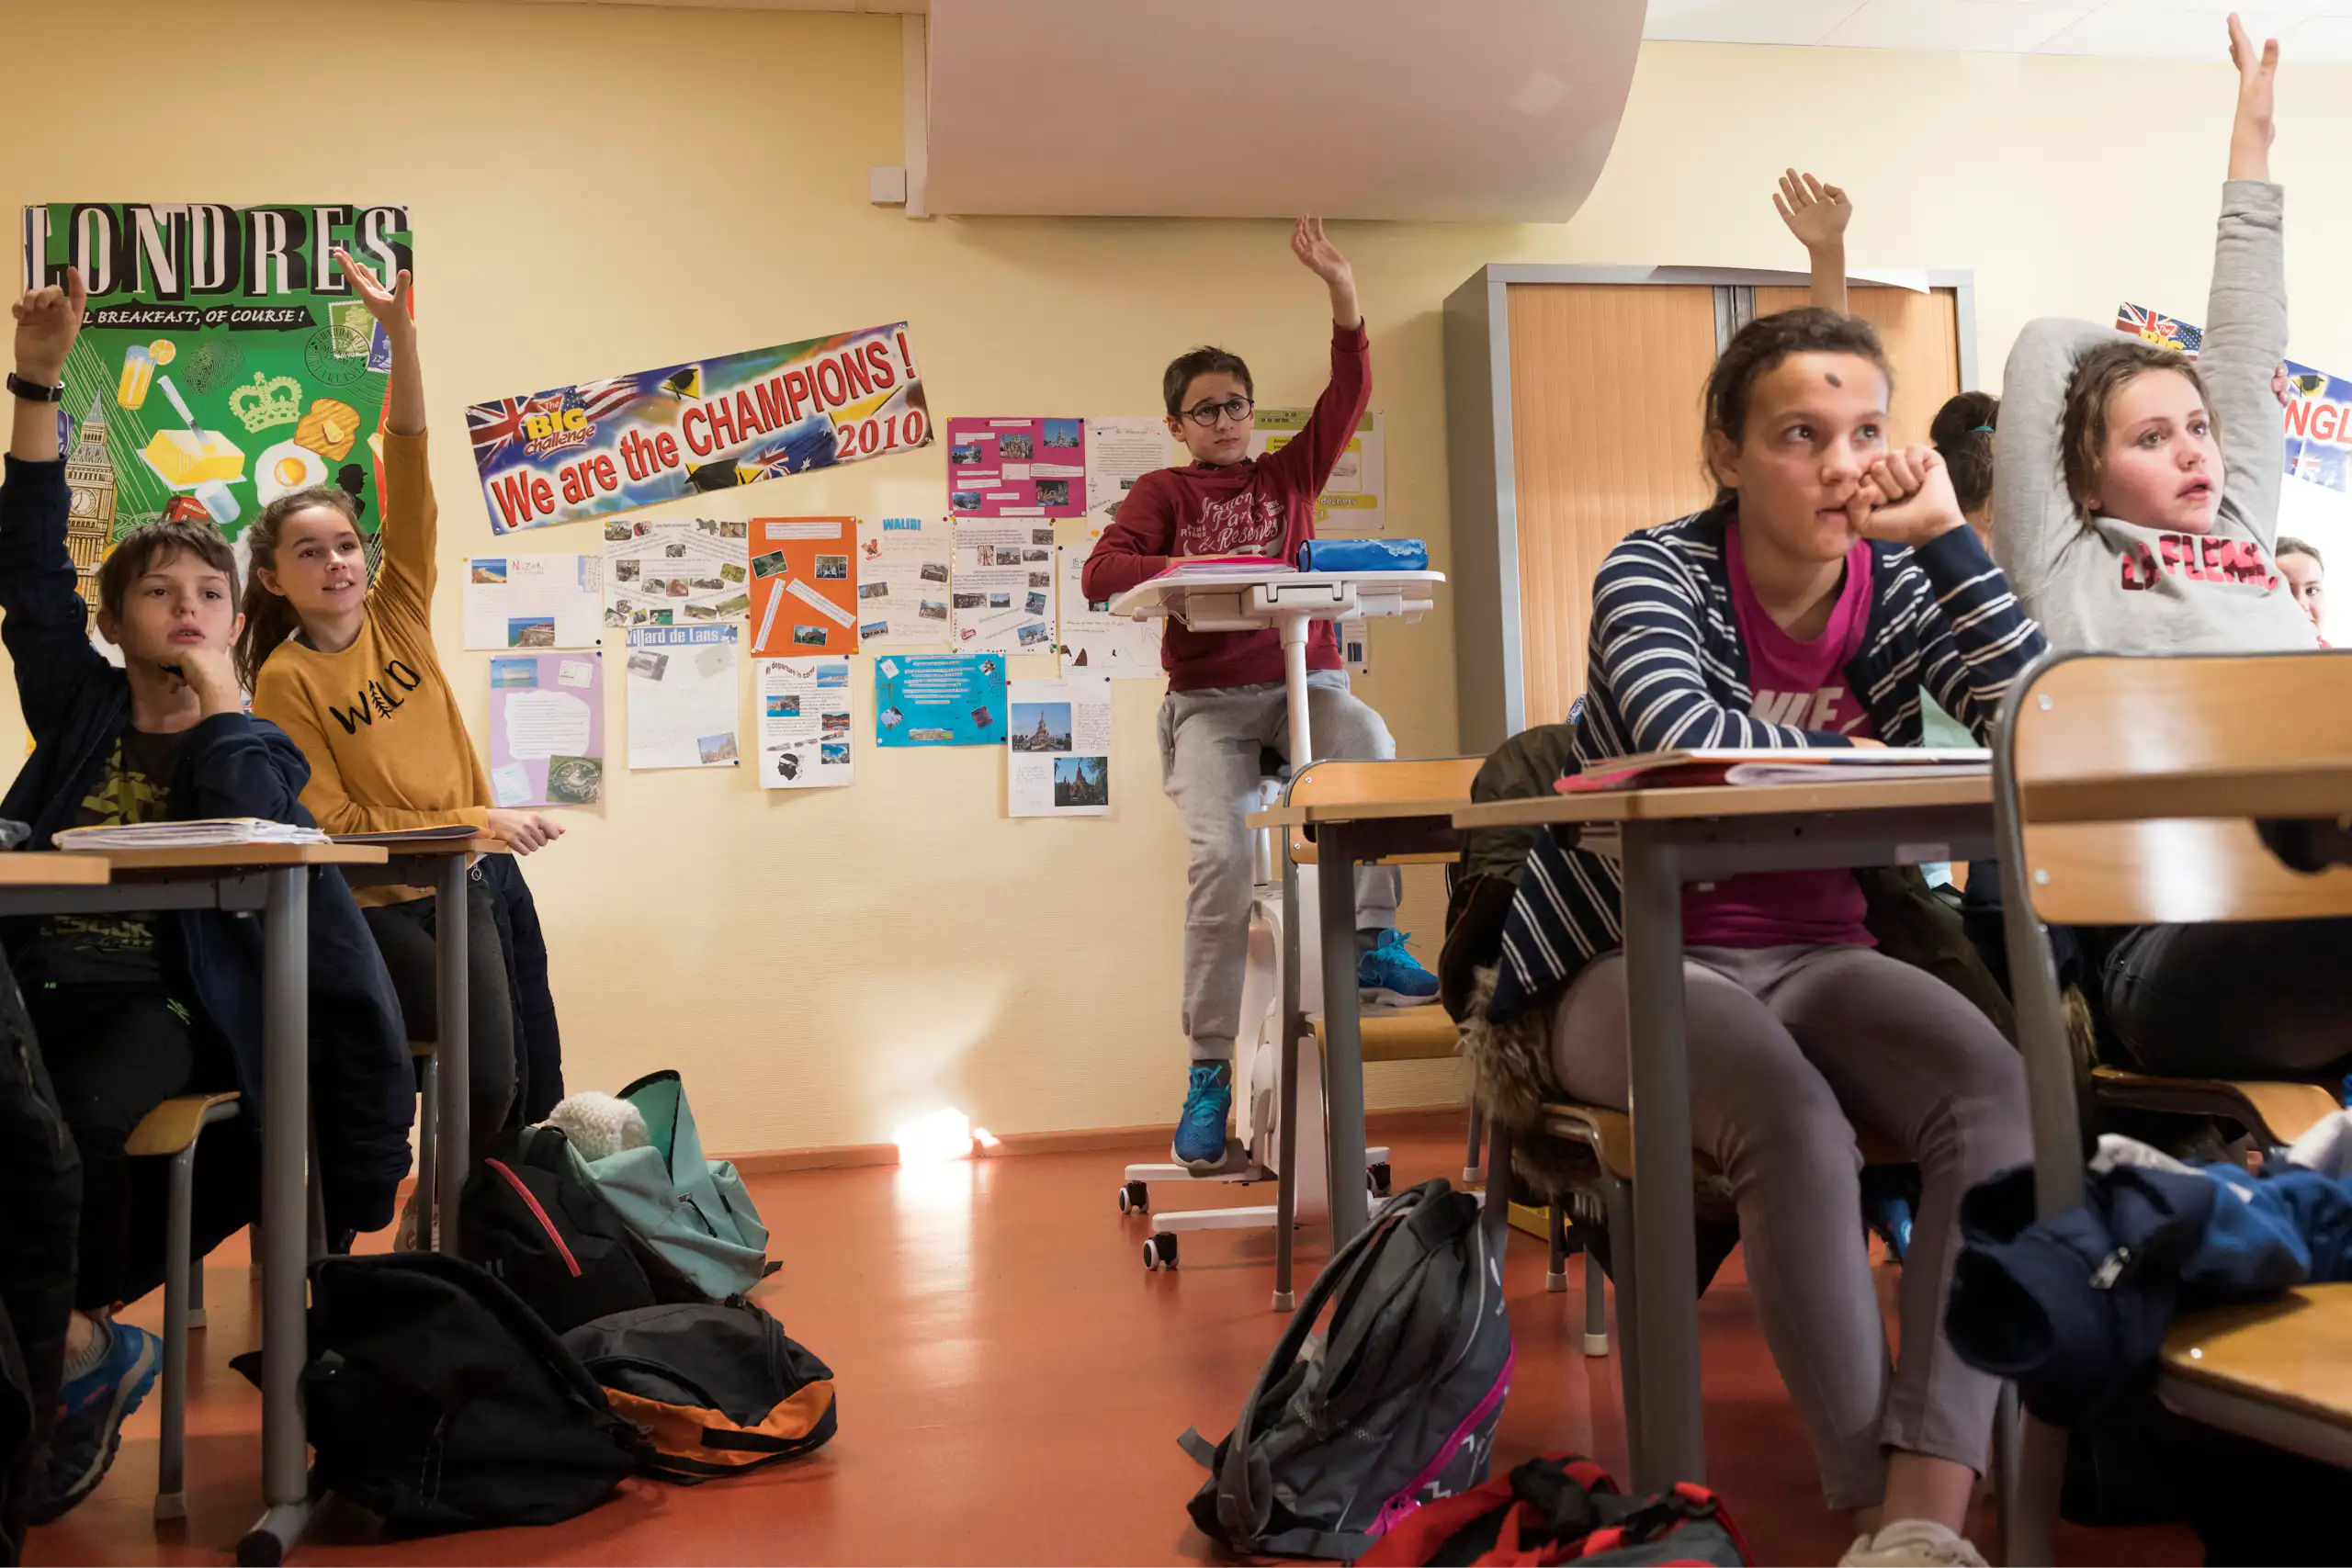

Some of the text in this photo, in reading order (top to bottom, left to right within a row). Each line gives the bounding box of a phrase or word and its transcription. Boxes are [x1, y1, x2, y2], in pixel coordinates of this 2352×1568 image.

[25, 203, 413, 299] LONDRES
[97, 310, 200, 326] BREAKFAST,
[206, 310, 229, 322] OF
[546, 401, 560, 410] The
[526, 408, 587, 440] BIG
[836, 411, 924, 458] 2010
[2284, 399, 2352, 444] NGL
[525, 423, 596, 455] challenge
[492, 470, 555, 527] We
[560, 453, 617, 504] are
[620, 425, 680, 481] the
[1320, 495, 1357, 505] déchets
[883, 517, 922, 531] WALIBI
[626, 627, 719, 647] Villard de Lans
[771, 661, 797, 676] departure
